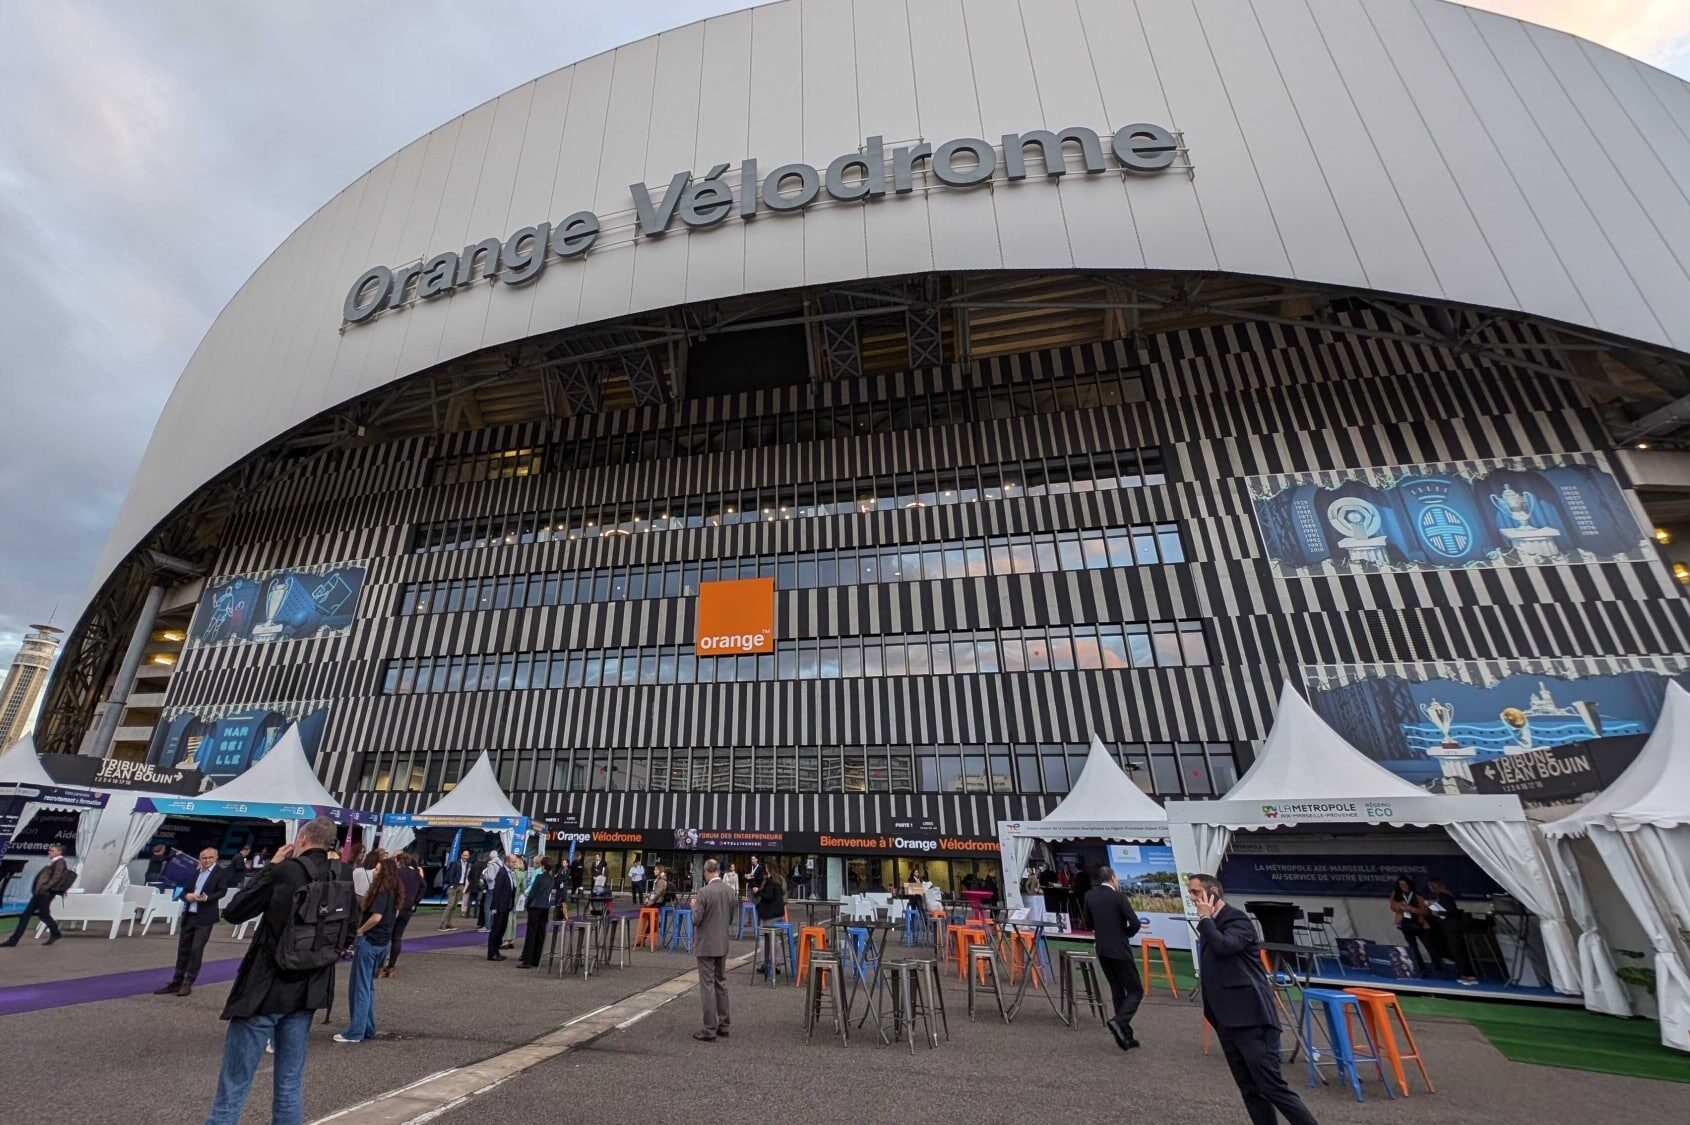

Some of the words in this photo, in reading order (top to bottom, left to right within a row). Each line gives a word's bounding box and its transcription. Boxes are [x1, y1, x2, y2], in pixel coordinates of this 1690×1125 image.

[343, 211, 598, 323] Orange
[629, 122, 1177, 237] Vélodrome
[700, 633, 764, 651] orange
[102, 758, 156, 774] TRIBUNE
[1492, 750, 1555, 770] TRIBUNE
[96, 767, 132, 780] JEAN
[134, 771, 172, 785] BOUIN
[1500, 765, 1537, 784] JEAN
[1538, 755, 1591, 778] BOUIN
[1367, 807, 1393, 818] ECO
[592, 830, 642, 843] Vélodrome
[733, 832, 782, 840] ENTREPRENEURS
[820, 836, 876, 848] Bienvenue
[879, 837, 887, 848] à
[939, 838, 1002, 851] Vélodrome
[1266, 863, 1312, 872] MÉTROPOLE
[1314, 865, 1428, 874] AIX-MARSEILLE-PROVENCE
[1331, 874, 1357, 882] VOTRE
